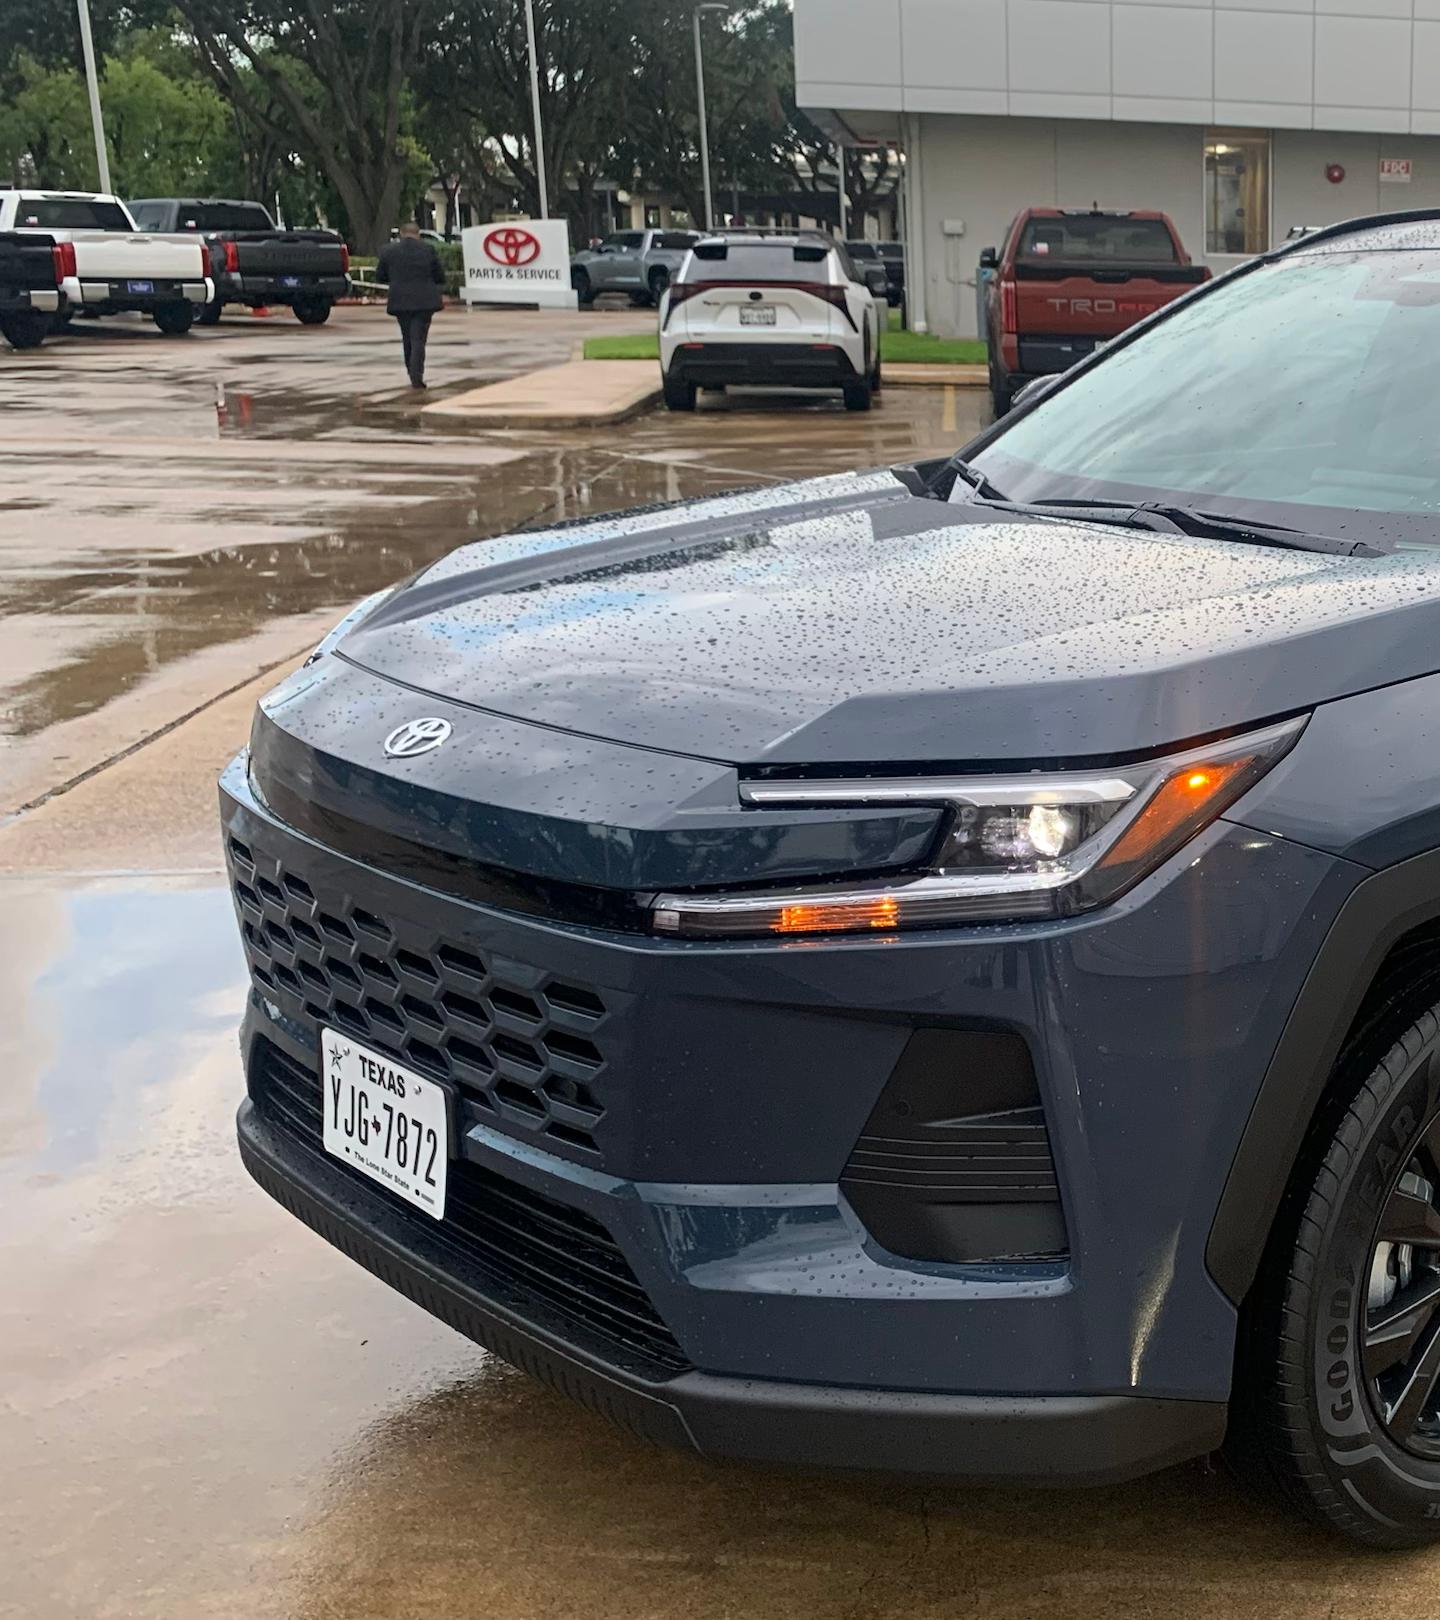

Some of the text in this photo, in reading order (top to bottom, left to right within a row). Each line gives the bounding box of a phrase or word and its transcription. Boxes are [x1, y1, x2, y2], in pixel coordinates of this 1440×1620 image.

[469, 268, 561, 280] PARTS & SERVICE
[359, 1054, 406, 1098] TEXAS
[354, 1151, 410, 1190] The Lone Star State
